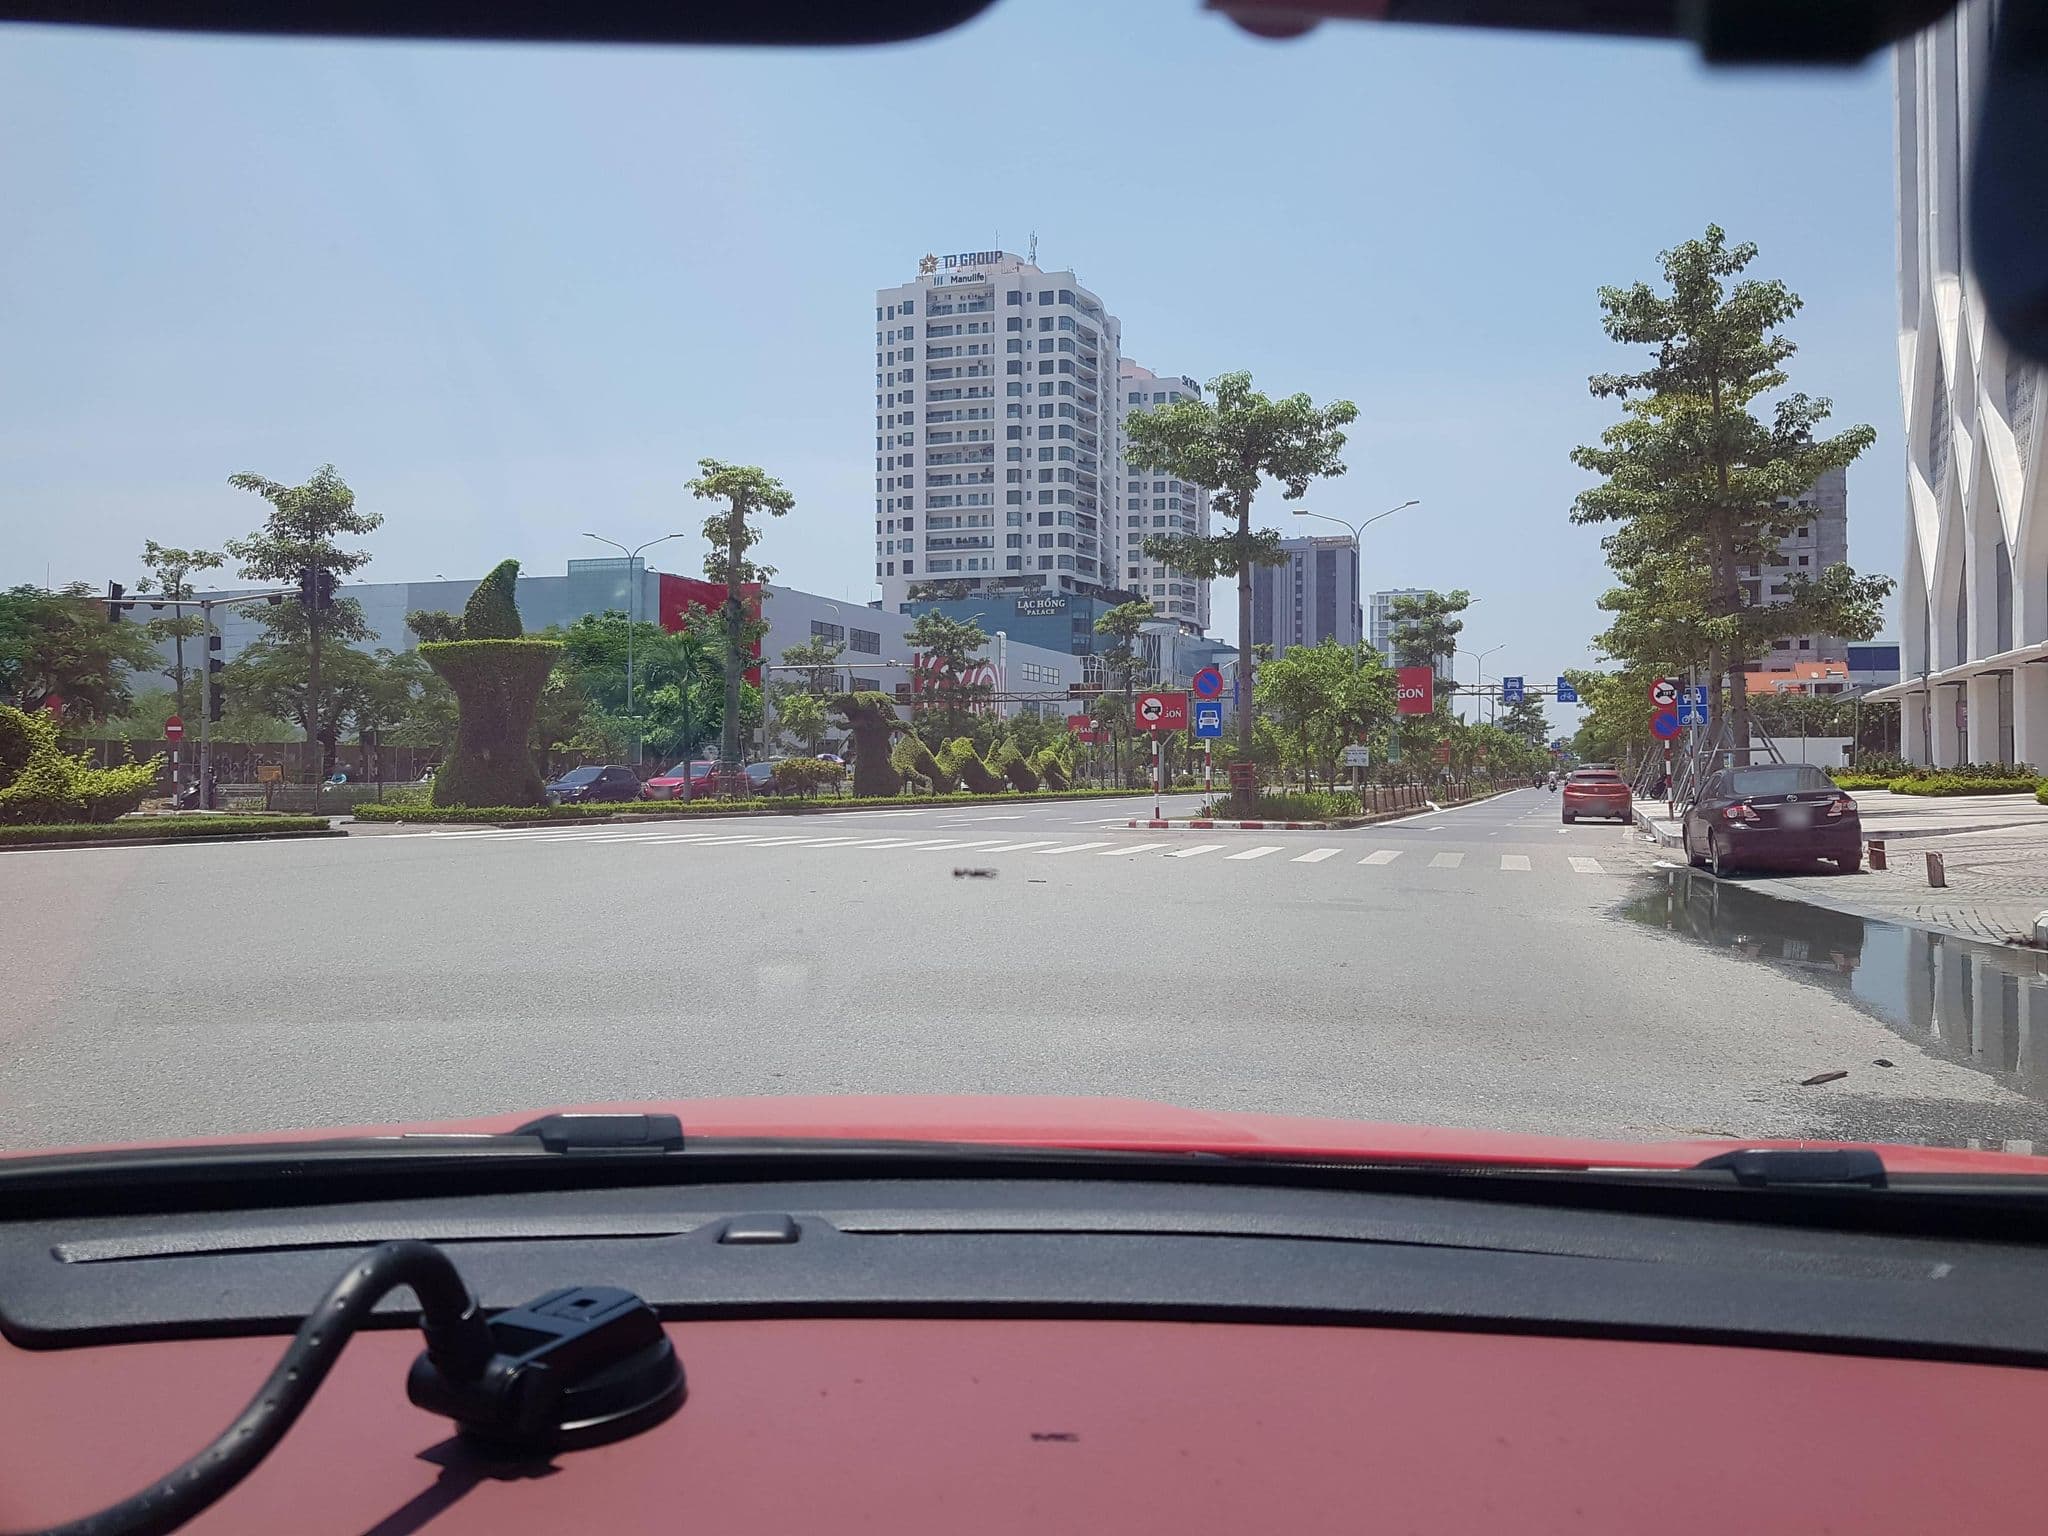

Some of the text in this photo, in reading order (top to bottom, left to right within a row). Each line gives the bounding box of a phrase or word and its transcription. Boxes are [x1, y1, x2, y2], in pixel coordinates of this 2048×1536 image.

[943, 251, 1003, 268] TD GROUP
[950, 272, 985, 283] Manulife
